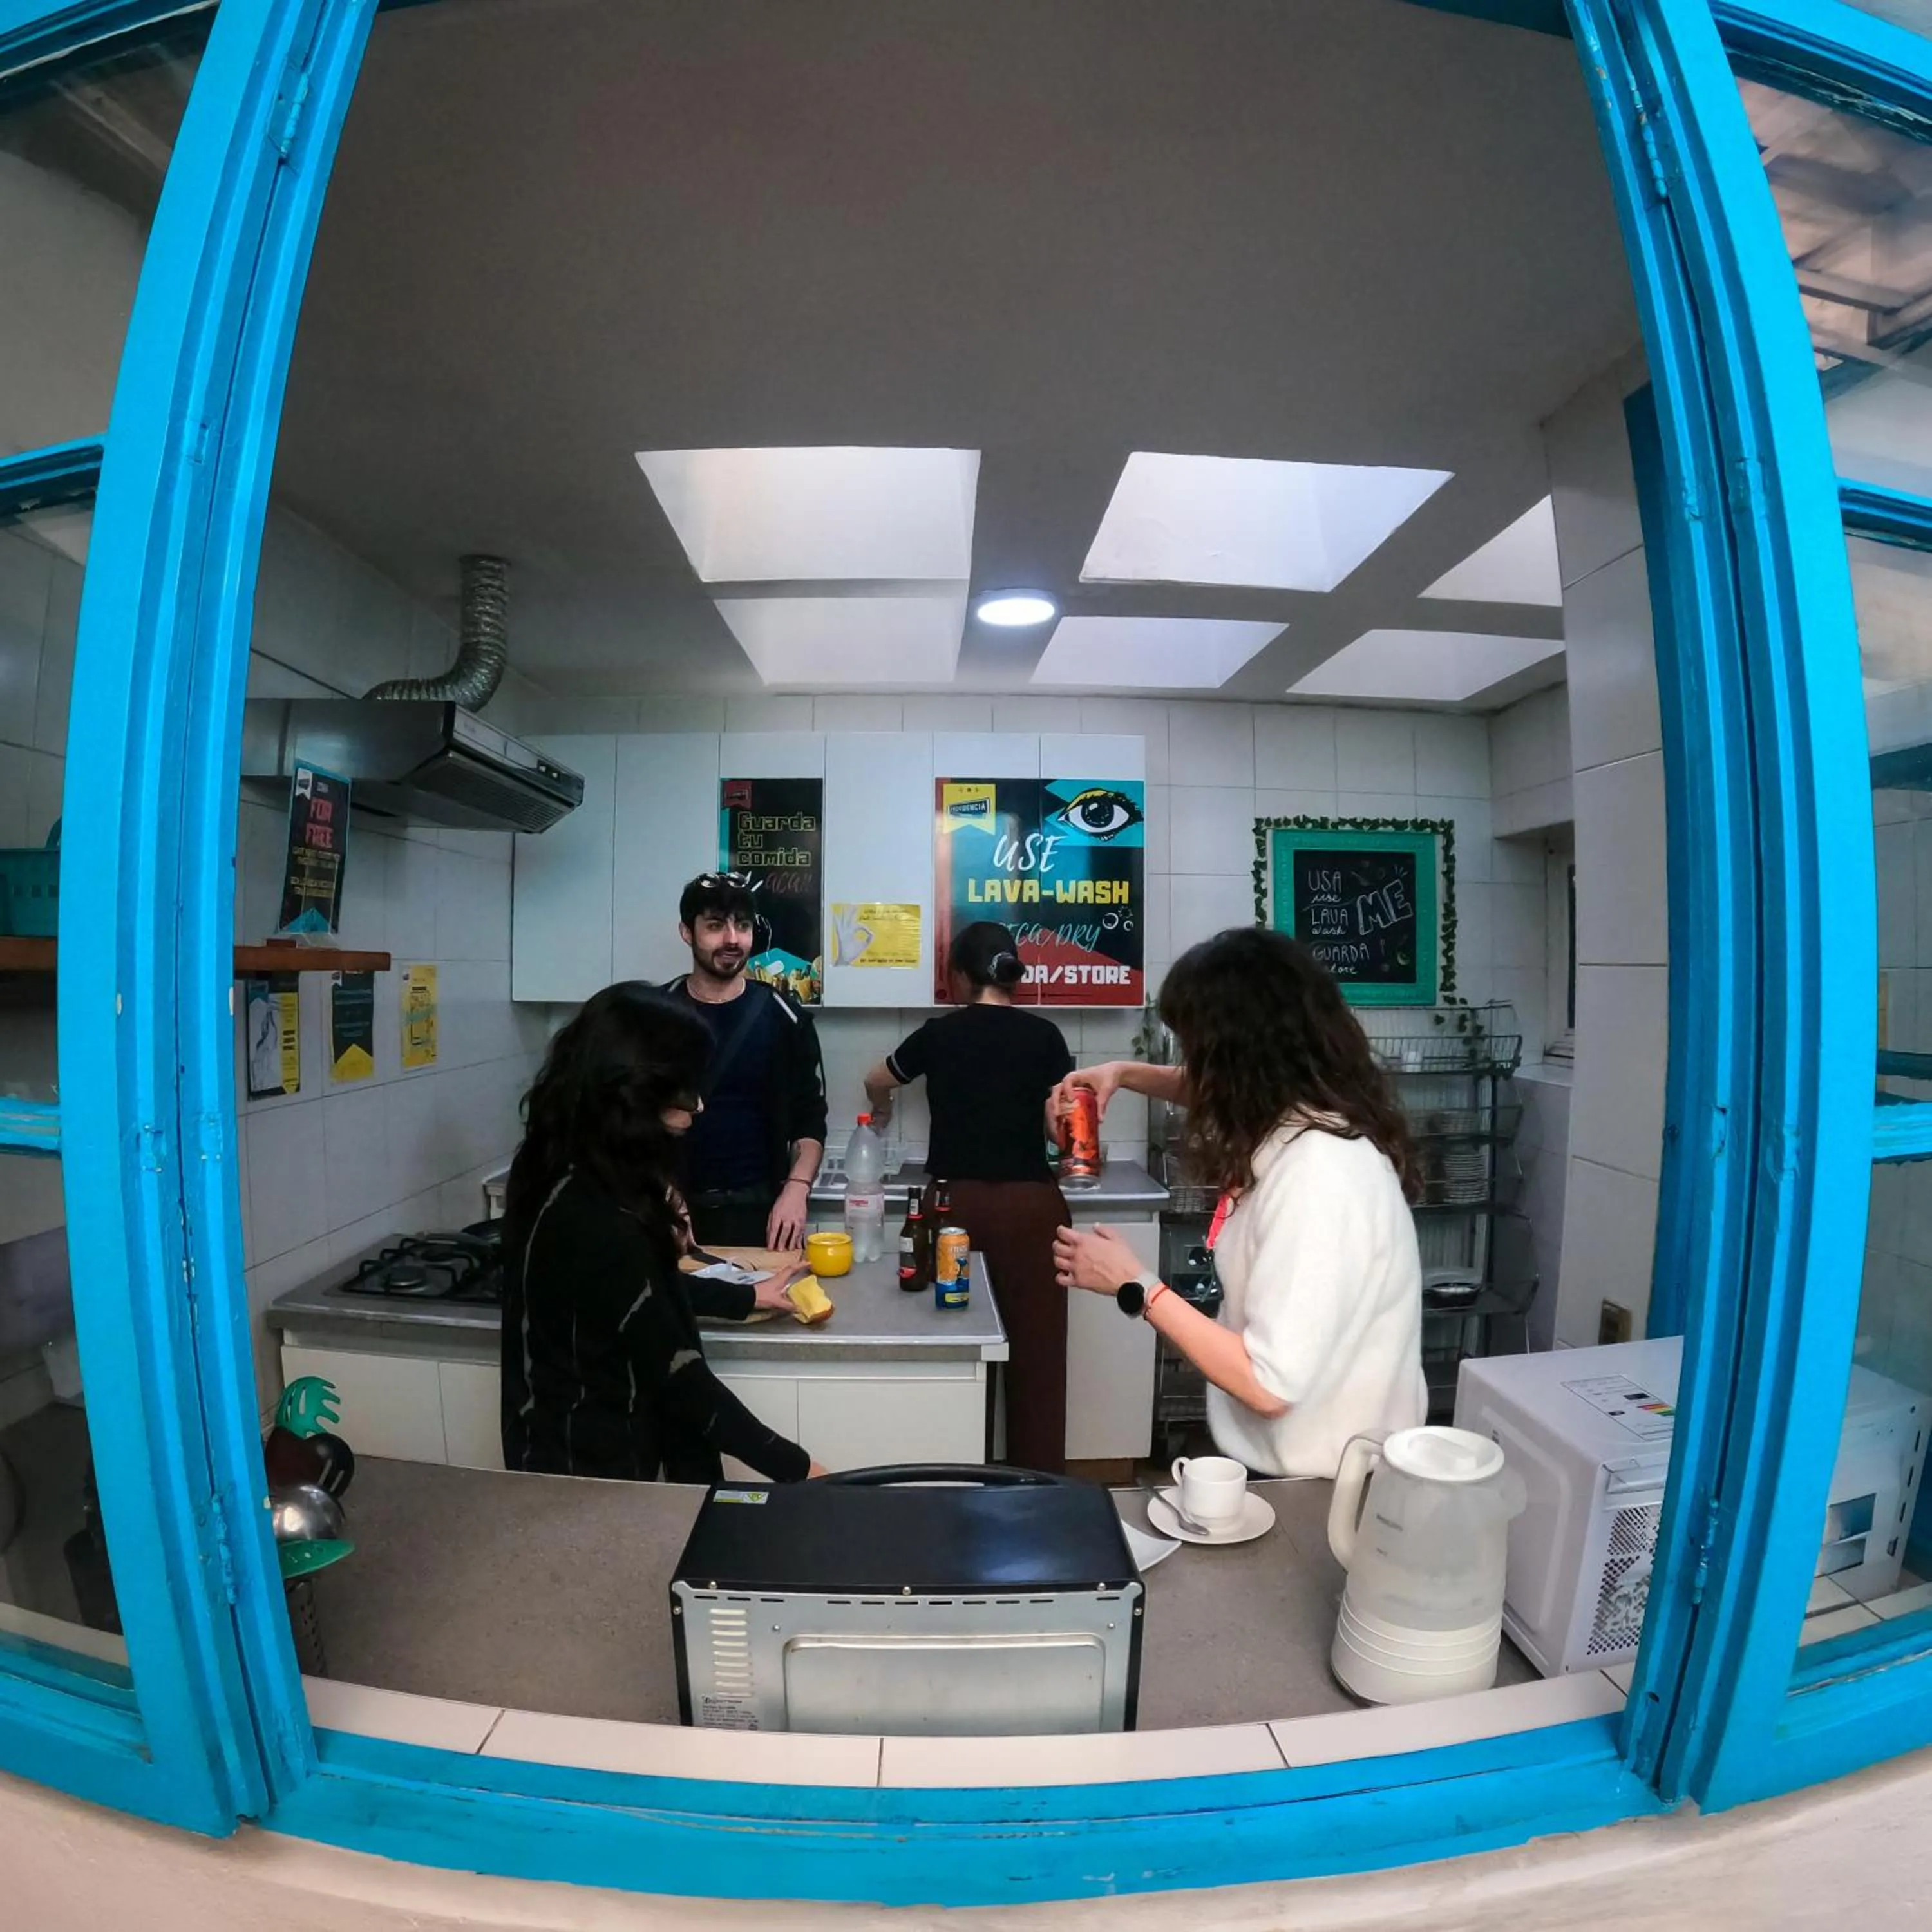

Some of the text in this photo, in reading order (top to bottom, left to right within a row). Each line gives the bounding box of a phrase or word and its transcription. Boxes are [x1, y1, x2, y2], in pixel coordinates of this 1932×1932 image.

[738, 811, 816, 831] Guarda
[737, 830, 763, 848] tu
[737, 847, 811, 866] comida
[992, 833, 1068, 872] USE
[968, 878, 1129, 904] LAVA-WASH
[1308, 870, 1341, 893] USA
[1356, 878, 1414, 935] ME
[1311, 908, 1349, 926] LAVA
[1312, 943, 1370, 963] GUARDA
[1021, 965, 1131, 985] DA/STORE
